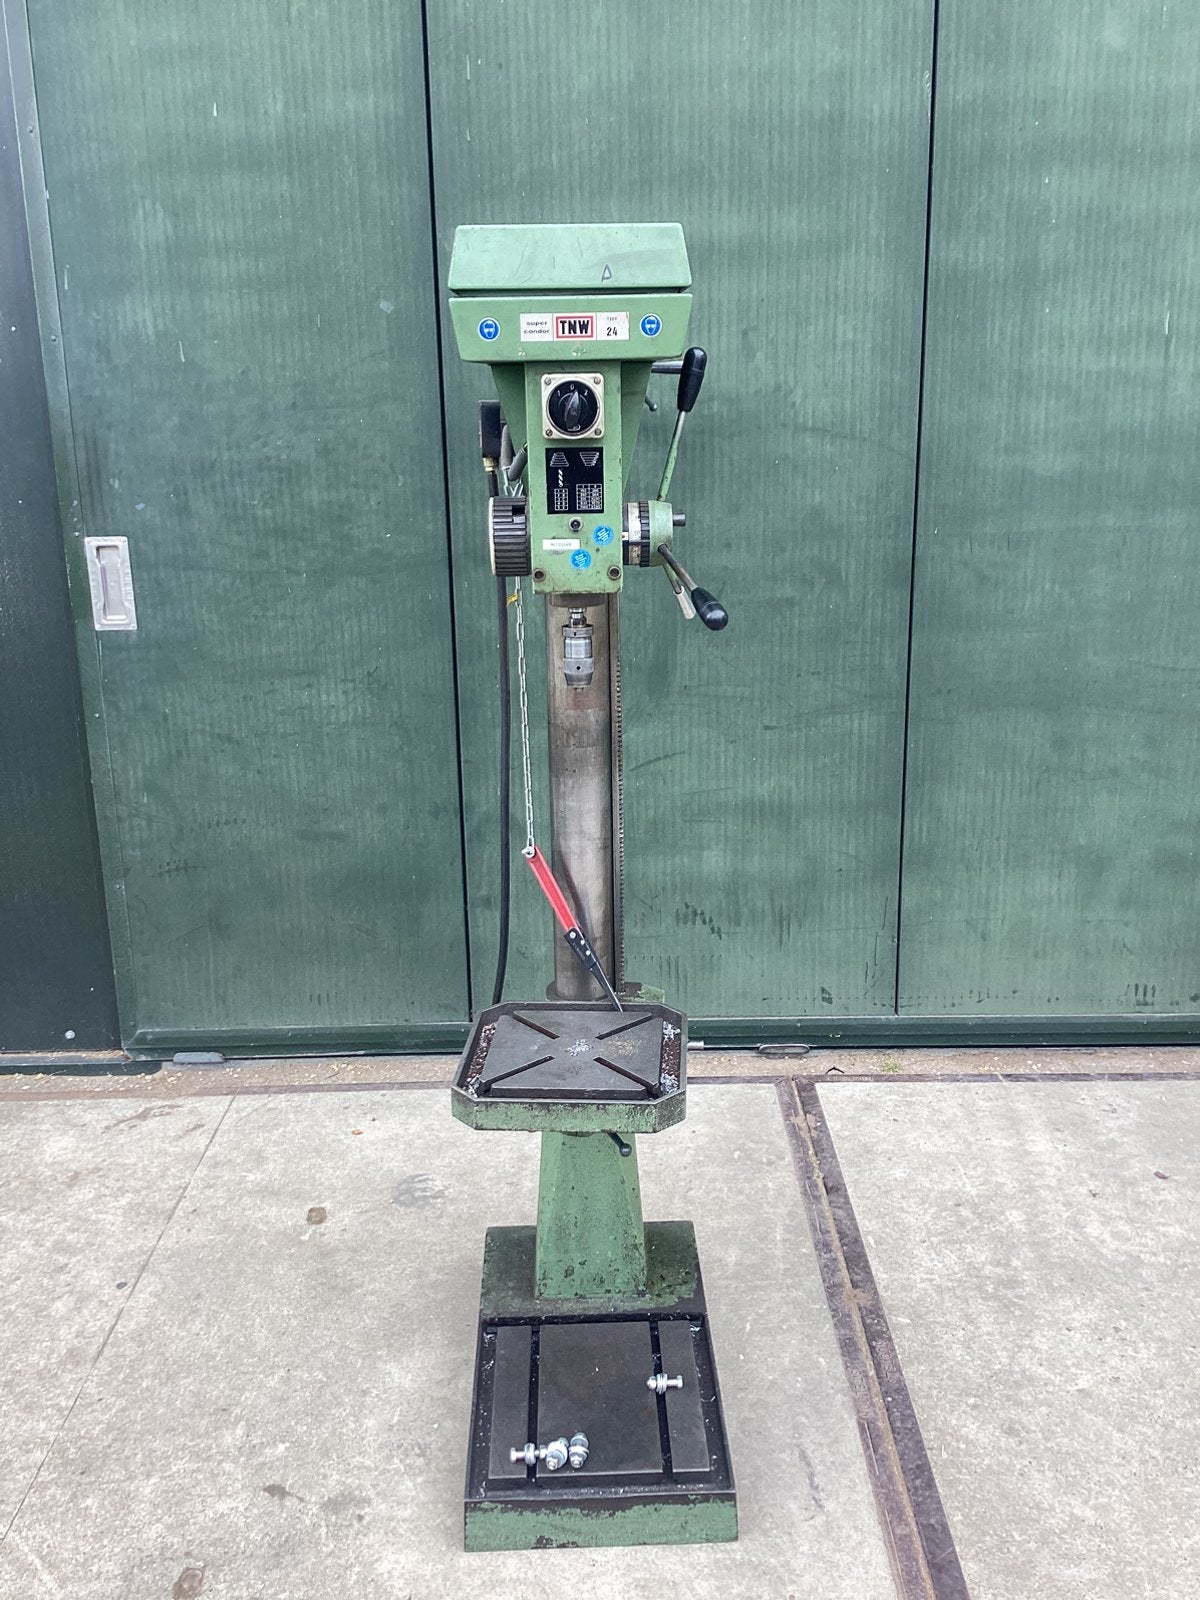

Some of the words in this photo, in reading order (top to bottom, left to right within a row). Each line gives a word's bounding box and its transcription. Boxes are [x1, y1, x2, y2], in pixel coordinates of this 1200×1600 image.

[526, 320, 547, 328] super
[560, 320, 590, 334] TNW
[606, 326, 617, 336] 24
